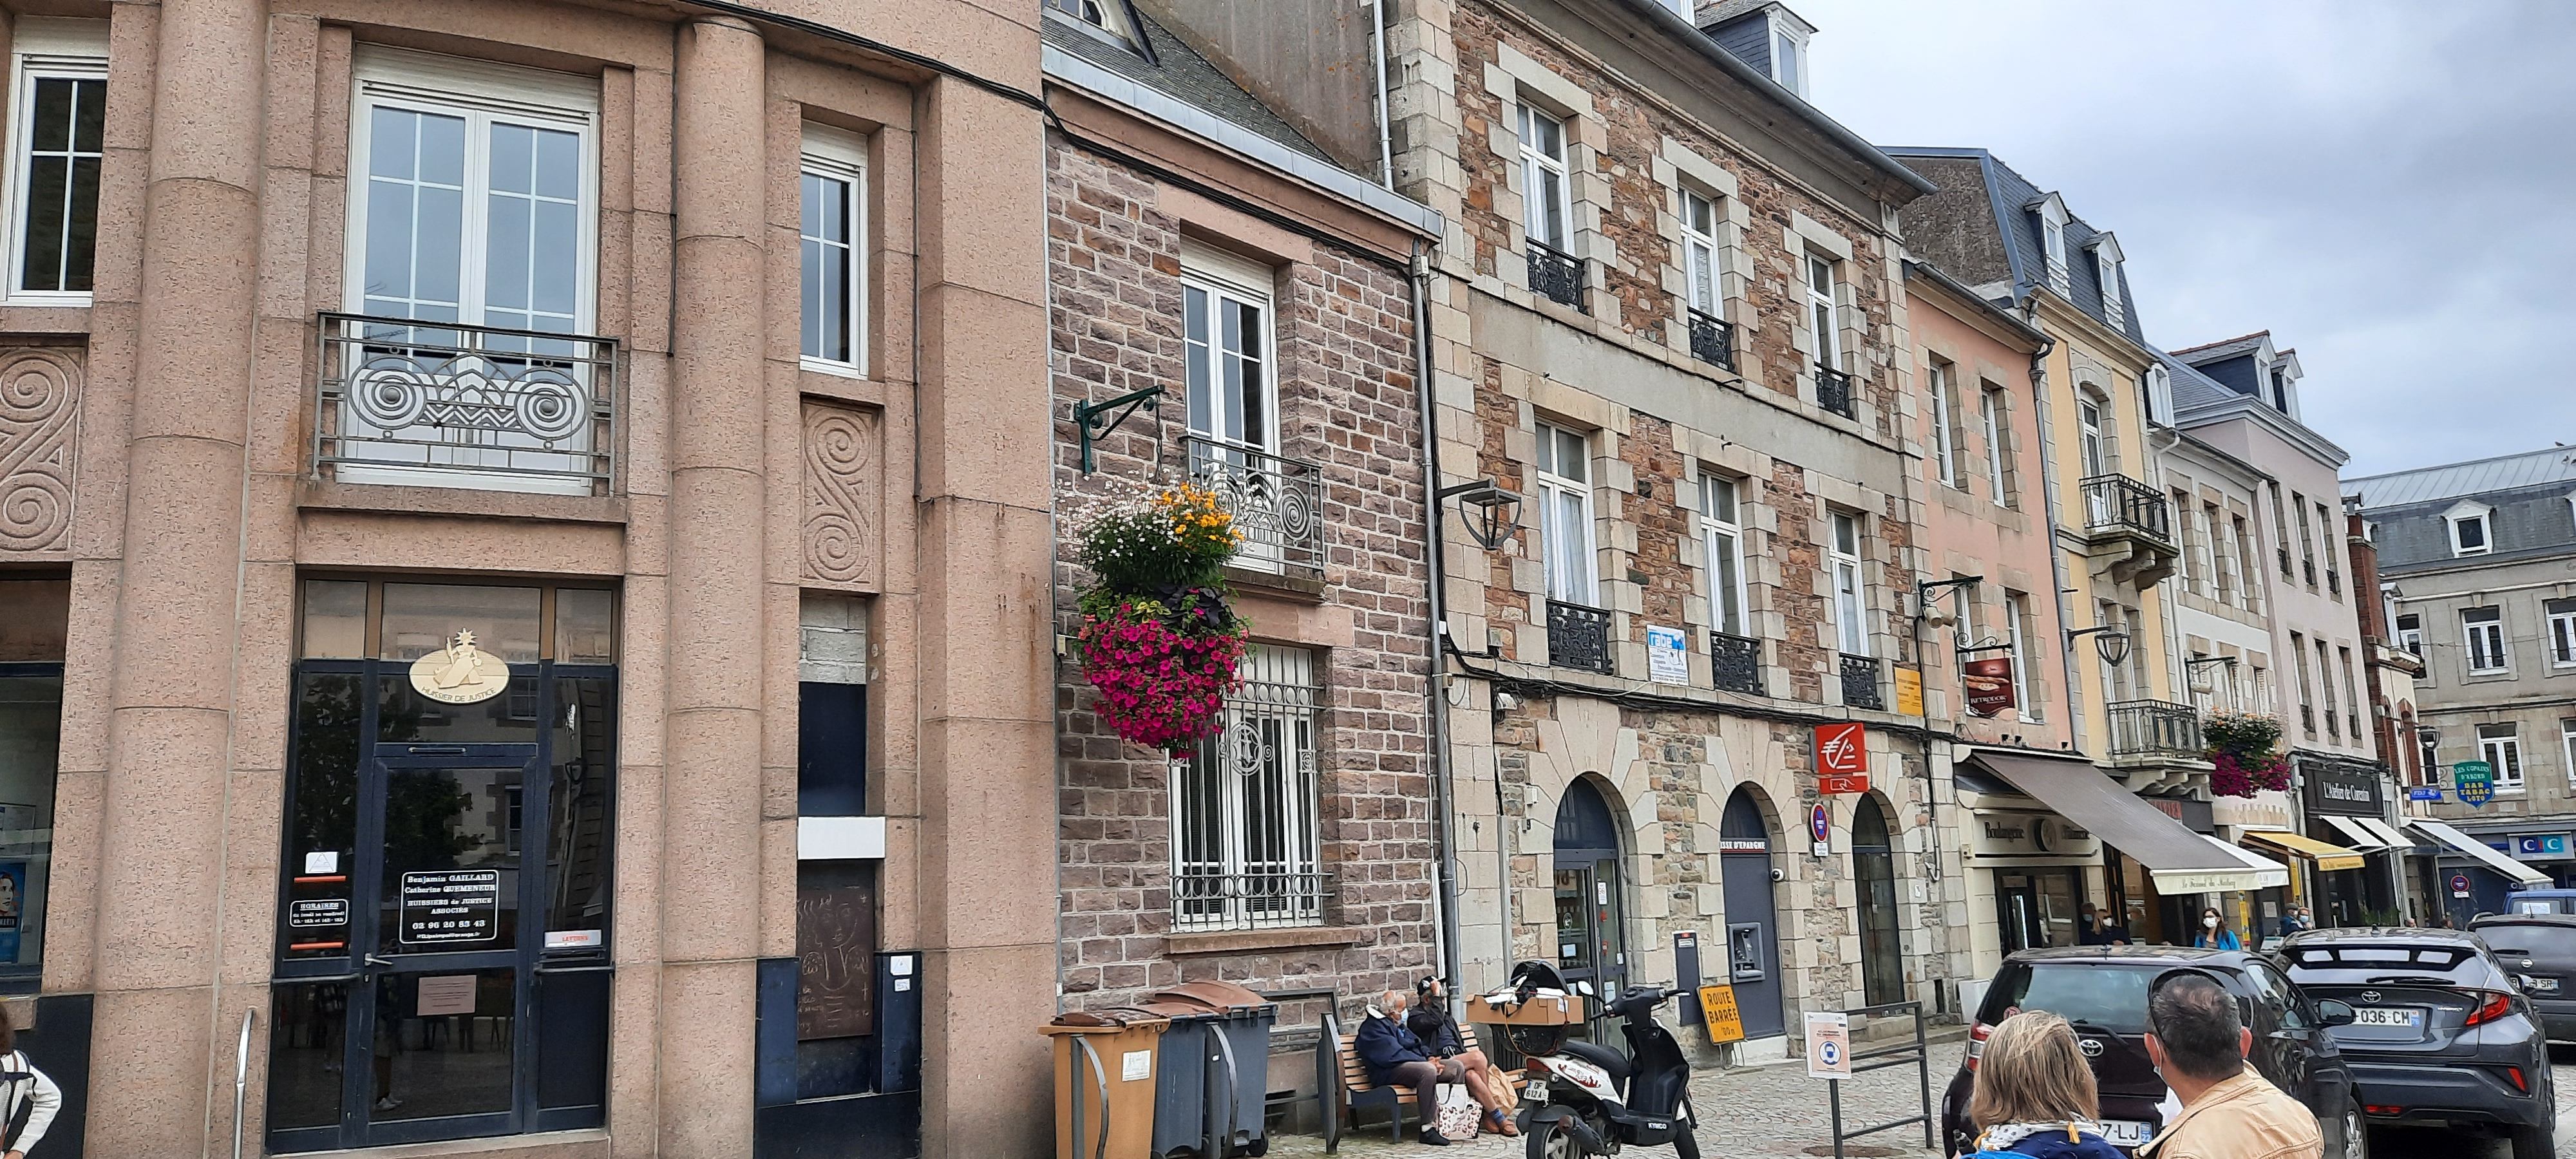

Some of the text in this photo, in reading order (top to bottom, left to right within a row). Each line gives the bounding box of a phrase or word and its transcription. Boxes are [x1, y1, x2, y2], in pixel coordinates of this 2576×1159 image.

[421, 686, 453, 701] HUISSIER
[468, 687, 497, 701] JUSTICE
[2523, 838, 2560, 851] CIC
[1707, 991, 1732, 1006] ROUTE
[1708, 1006, 1739, 1024] BARRÉE
[2141, 1134, 2151, 1142] 22
